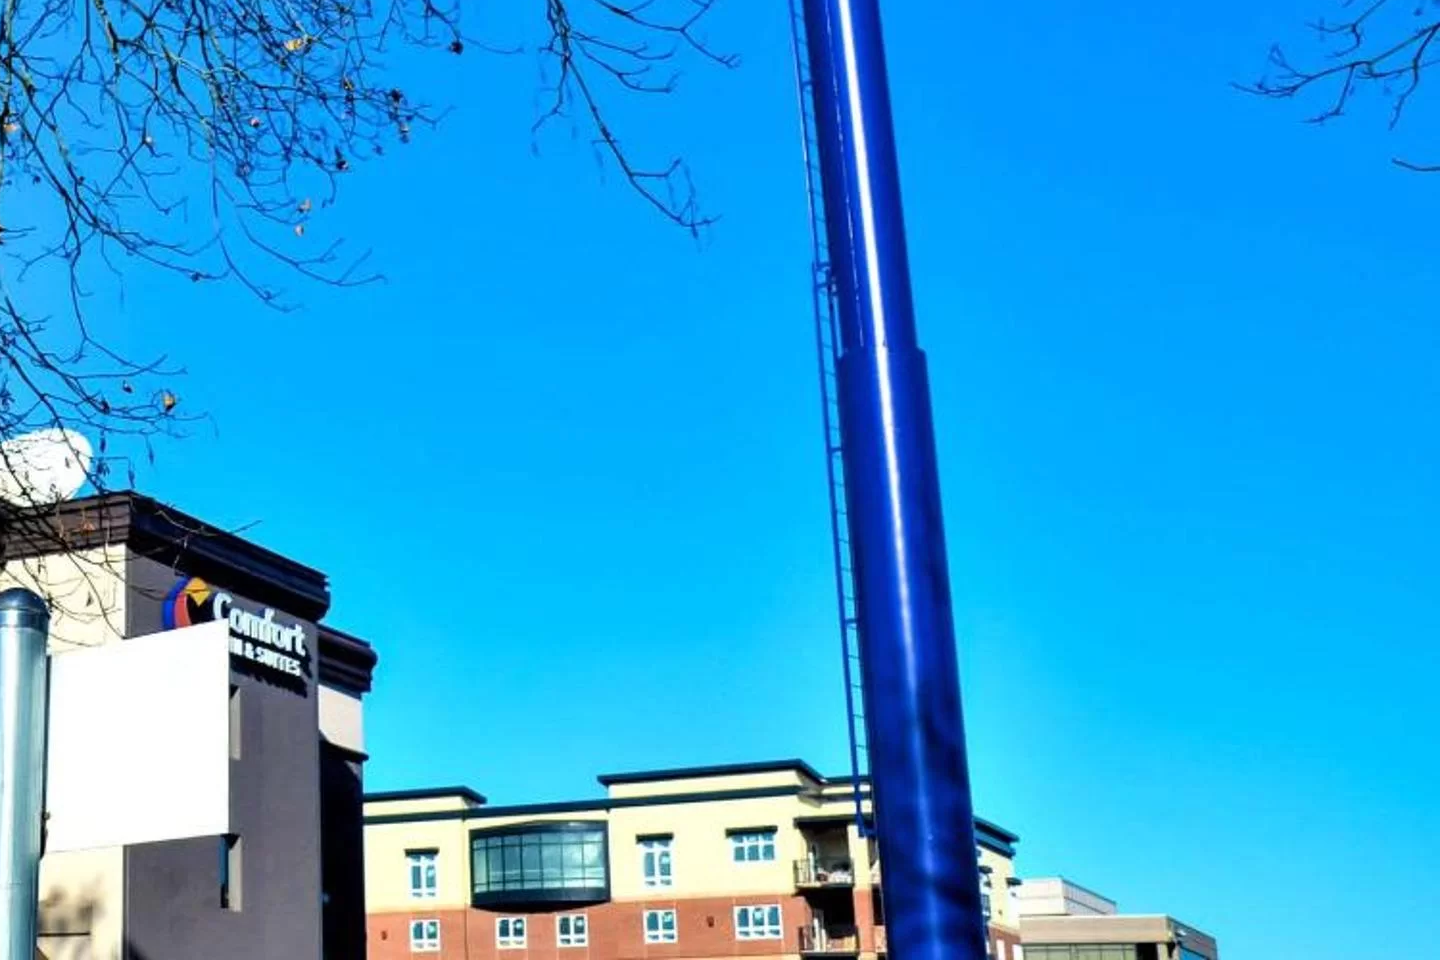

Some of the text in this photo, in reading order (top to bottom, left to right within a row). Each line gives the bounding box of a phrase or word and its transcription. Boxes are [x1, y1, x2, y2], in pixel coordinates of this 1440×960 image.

[213, 592, 306, 657] Comfort
[244, 641, 255, 660] &
[255, 646, 301, 677] SUITES
